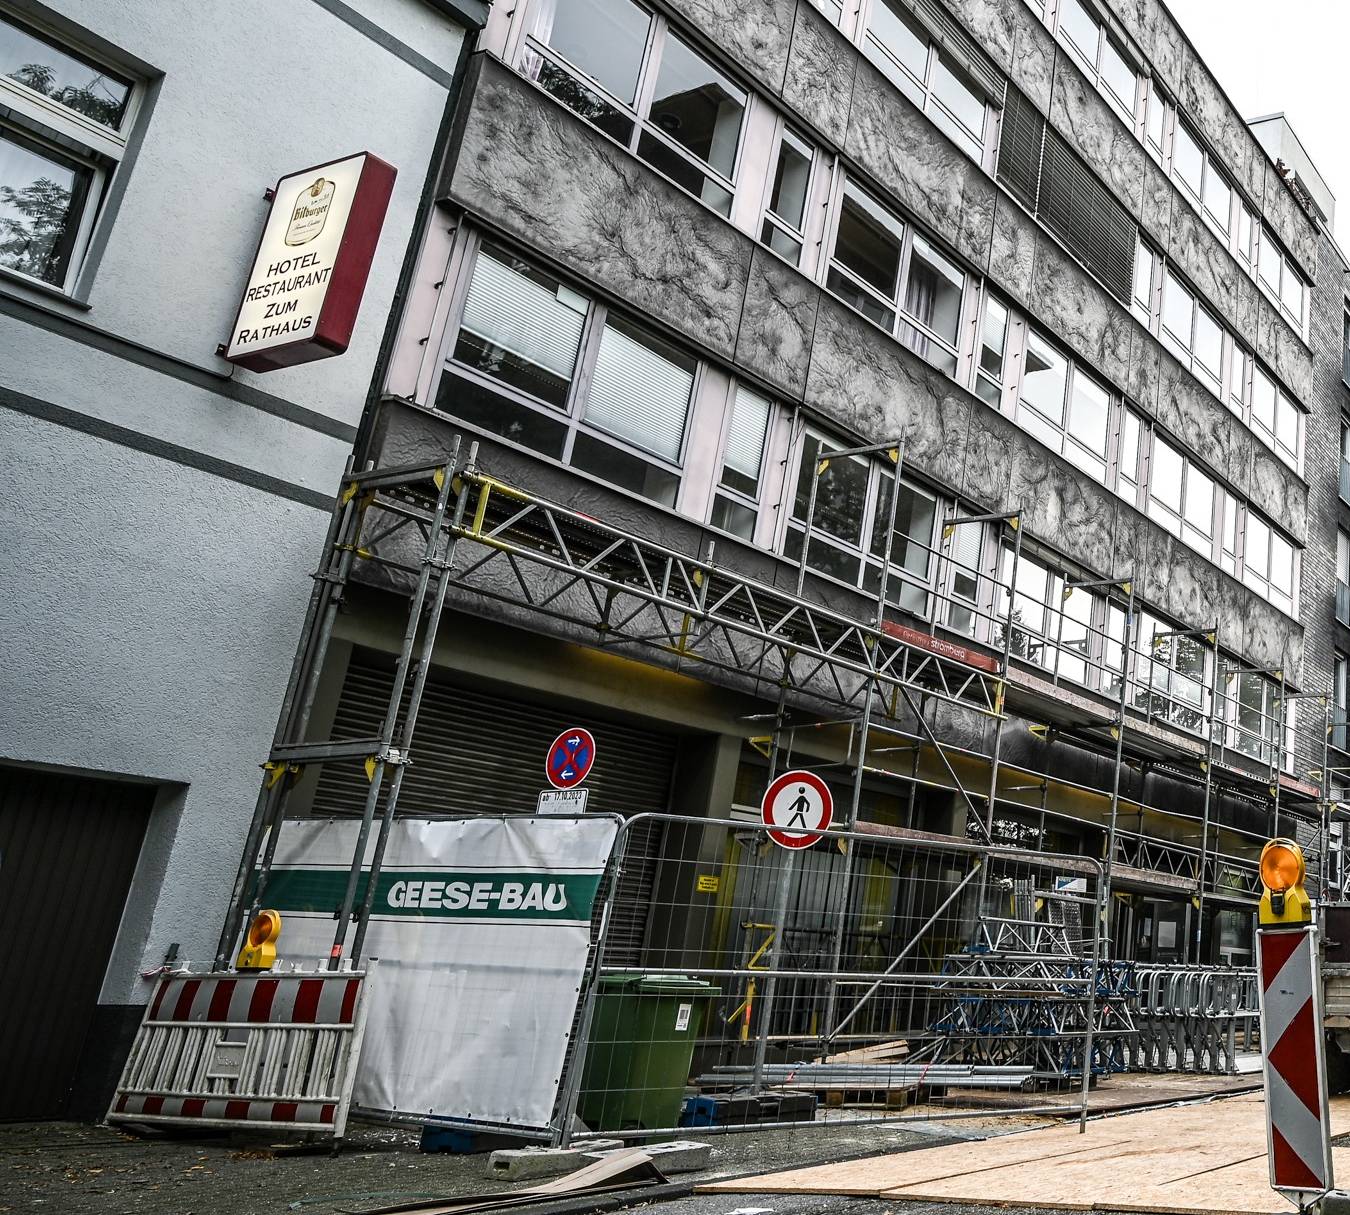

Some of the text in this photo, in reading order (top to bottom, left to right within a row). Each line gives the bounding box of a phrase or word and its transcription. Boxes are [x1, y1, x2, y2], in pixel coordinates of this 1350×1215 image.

[293, 205, 327, 220] Bitburger
[266, 252, 320, 278] HOTEL
[246, 267, 331, 302] RESTAURANT
[264, 299, 299, 319] ZUM
[236, 315, 313, 345] RATHAUS
[387, 880, 568, 912] GEESE-BAU
